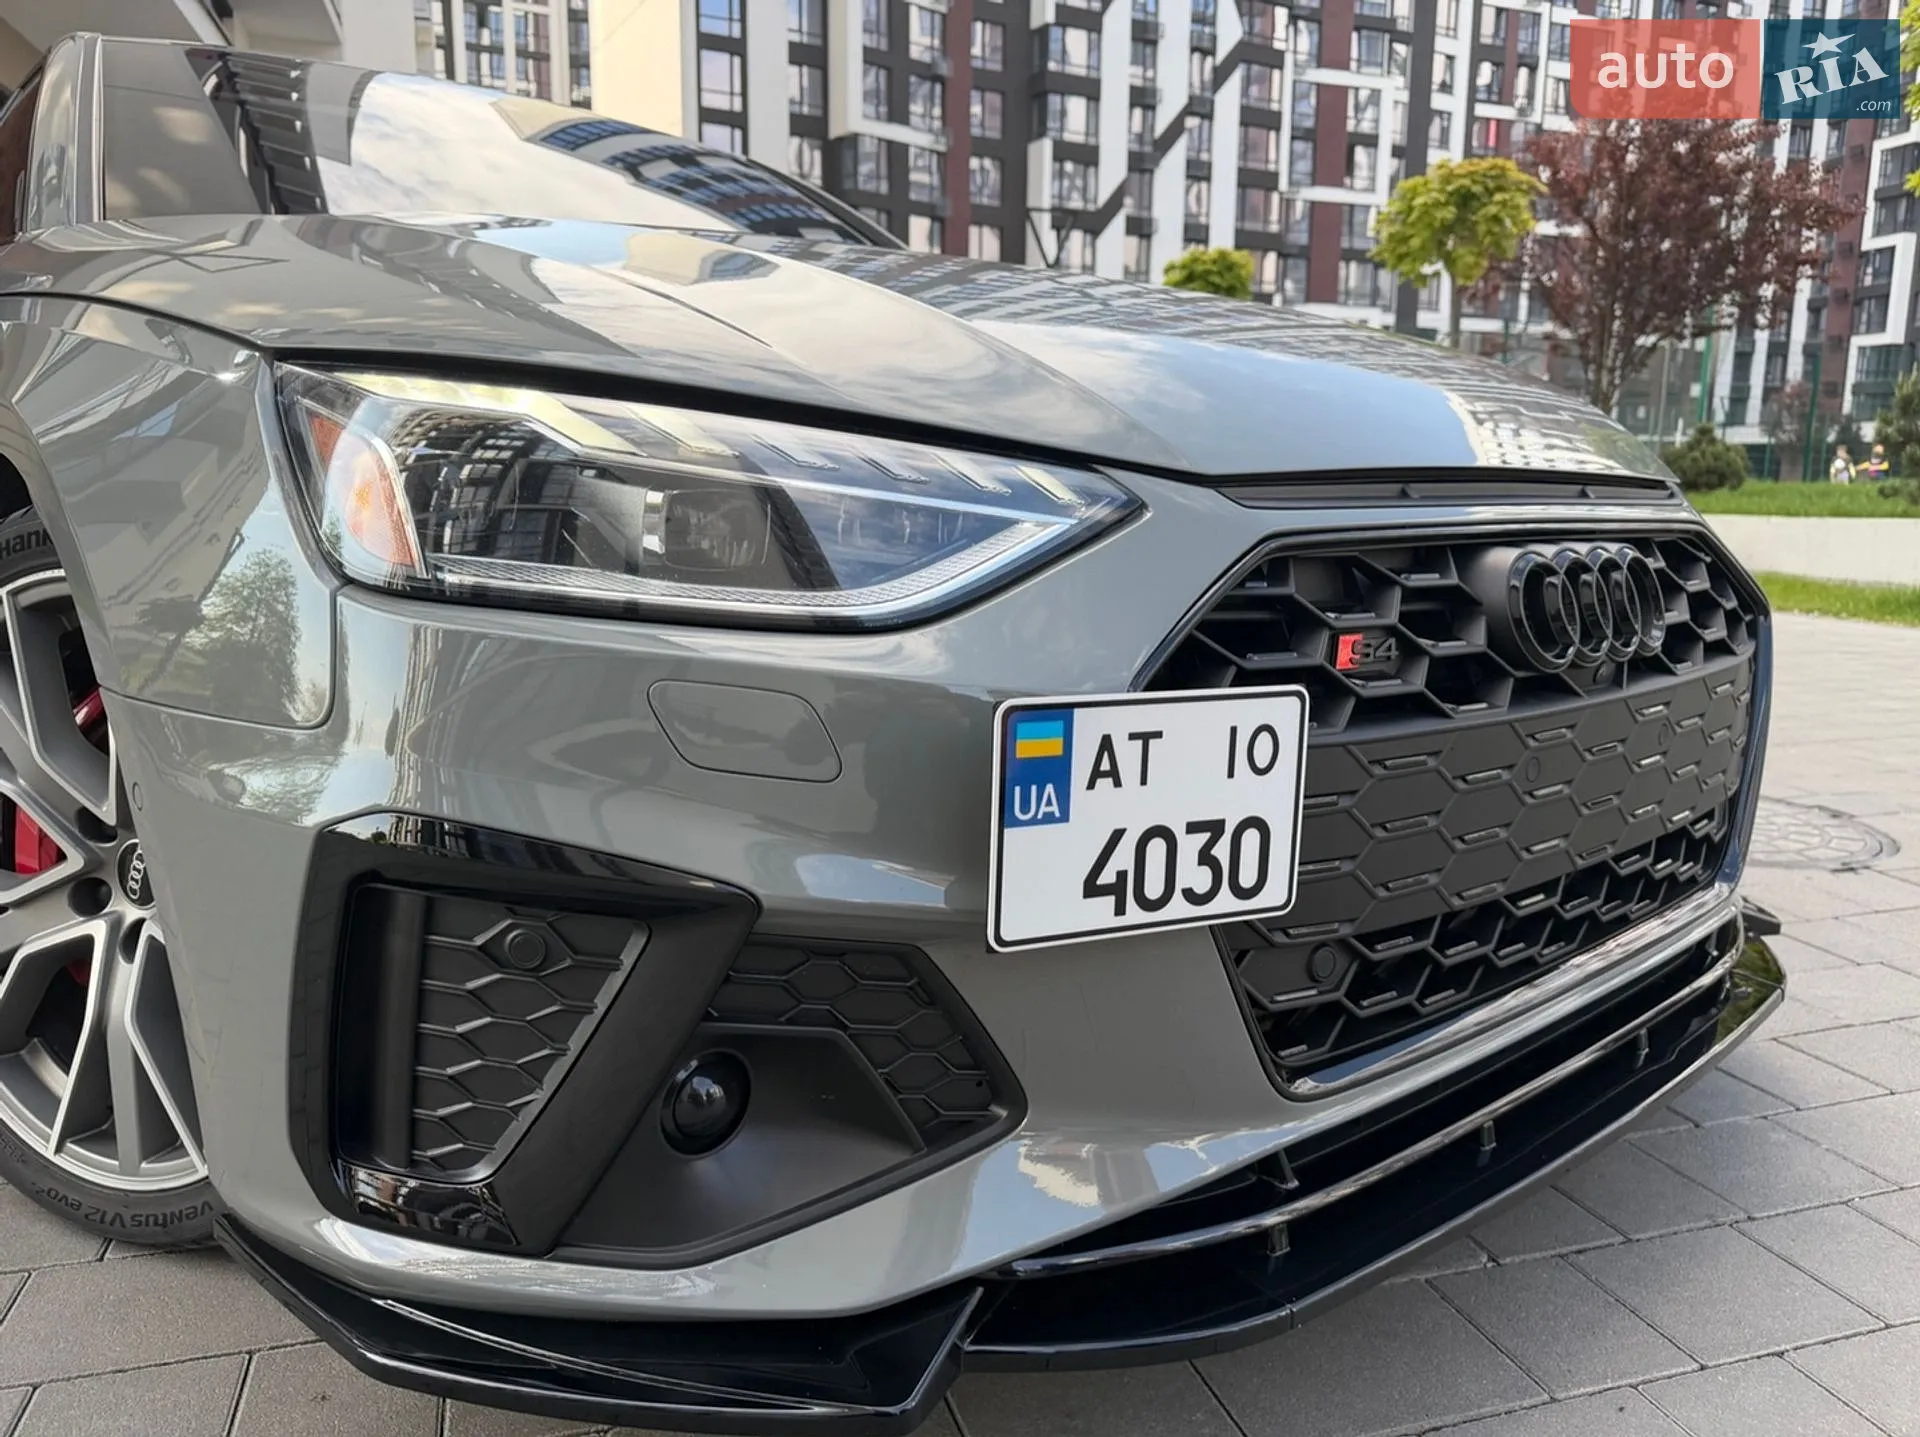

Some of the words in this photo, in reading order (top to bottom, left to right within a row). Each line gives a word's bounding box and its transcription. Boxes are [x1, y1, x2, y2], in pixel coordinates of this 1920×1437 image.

[1348, 636, 1399, 665] S4
[1086, 730, 1164, 791] AT
[1226, 723, 1280, 779] IO
[1013, 783, 1061, 821] UA
[1082, 815, 1271, 917] 4030
[84, 1206, 126, 1229] V12
